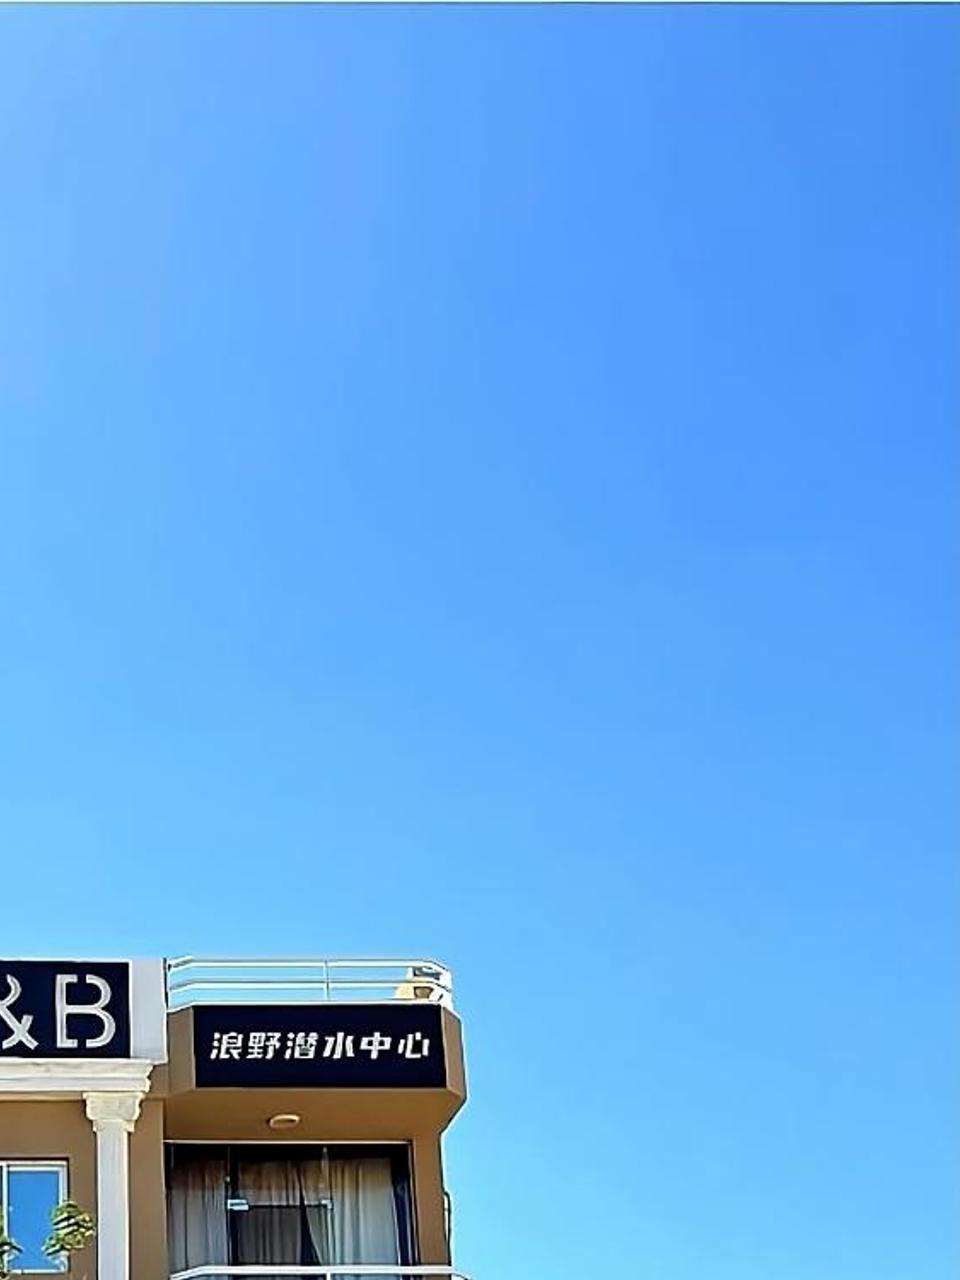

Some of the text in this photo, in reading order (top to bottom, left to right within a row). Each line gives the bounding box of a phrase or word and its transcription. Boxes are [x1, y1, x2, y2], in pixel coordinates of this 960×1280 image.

[210, 1031, 430, 1060] 浪野潜水中心
